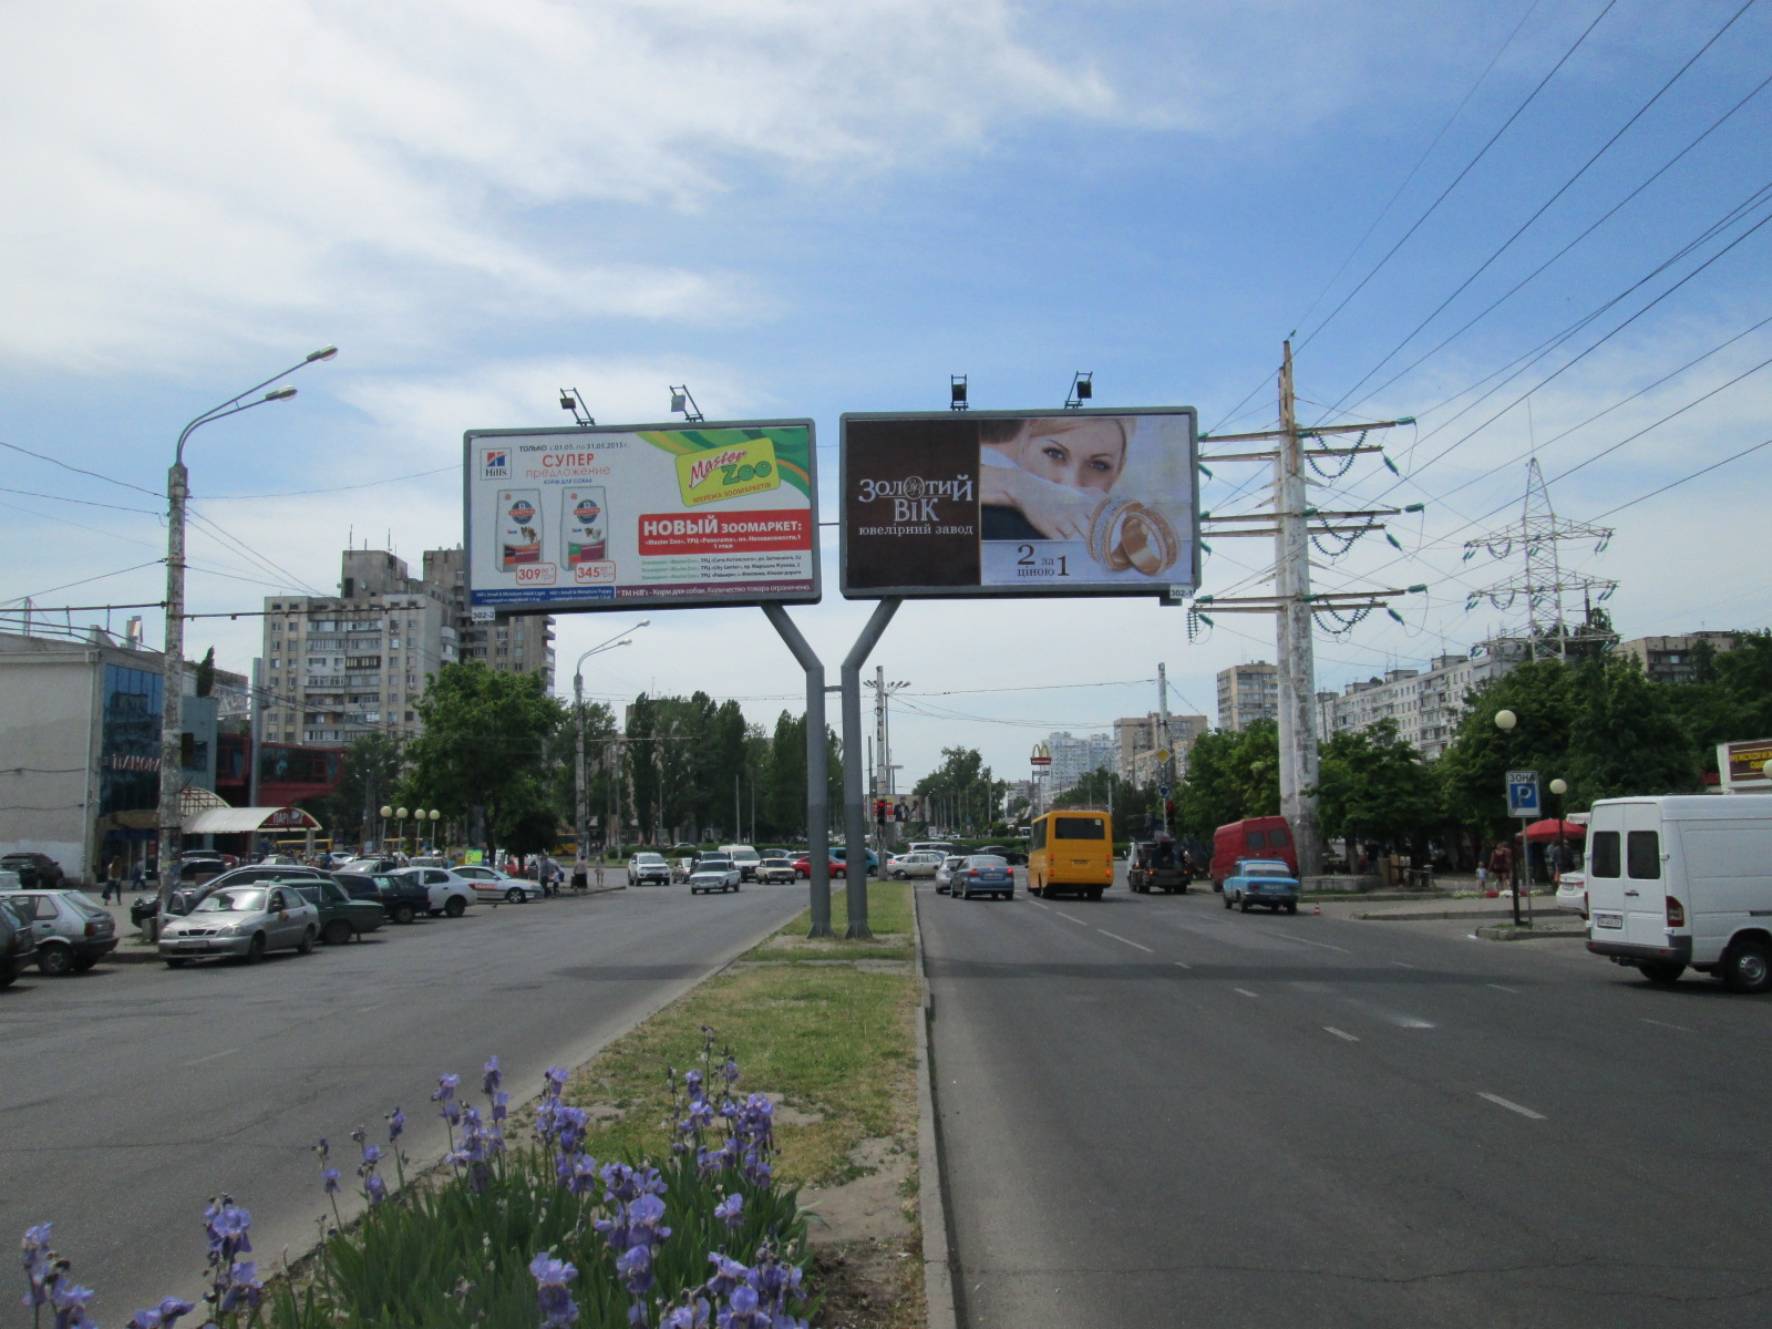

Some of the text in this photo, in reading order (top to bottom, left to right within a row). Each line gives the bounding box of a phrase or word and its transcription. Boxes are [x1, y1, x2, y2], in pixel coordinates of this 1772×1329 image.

[542, 452, 595, 468] СУПЕР
[526, 465, 612, 480] предложение
[688, 448, 748, 489] Master
[643, 514, 718, 537] НОВЫЙ
[858, 523, 974, 537] ювелірний завод
[1017, 543, 1070, 577] 2 за 1
[518, 568, 541, 580] 309
[577, 566, 600, 579] 345
[1017, 565, 1055, 578] ціною
[1509, 773, 1537, 783] ЗОНА
